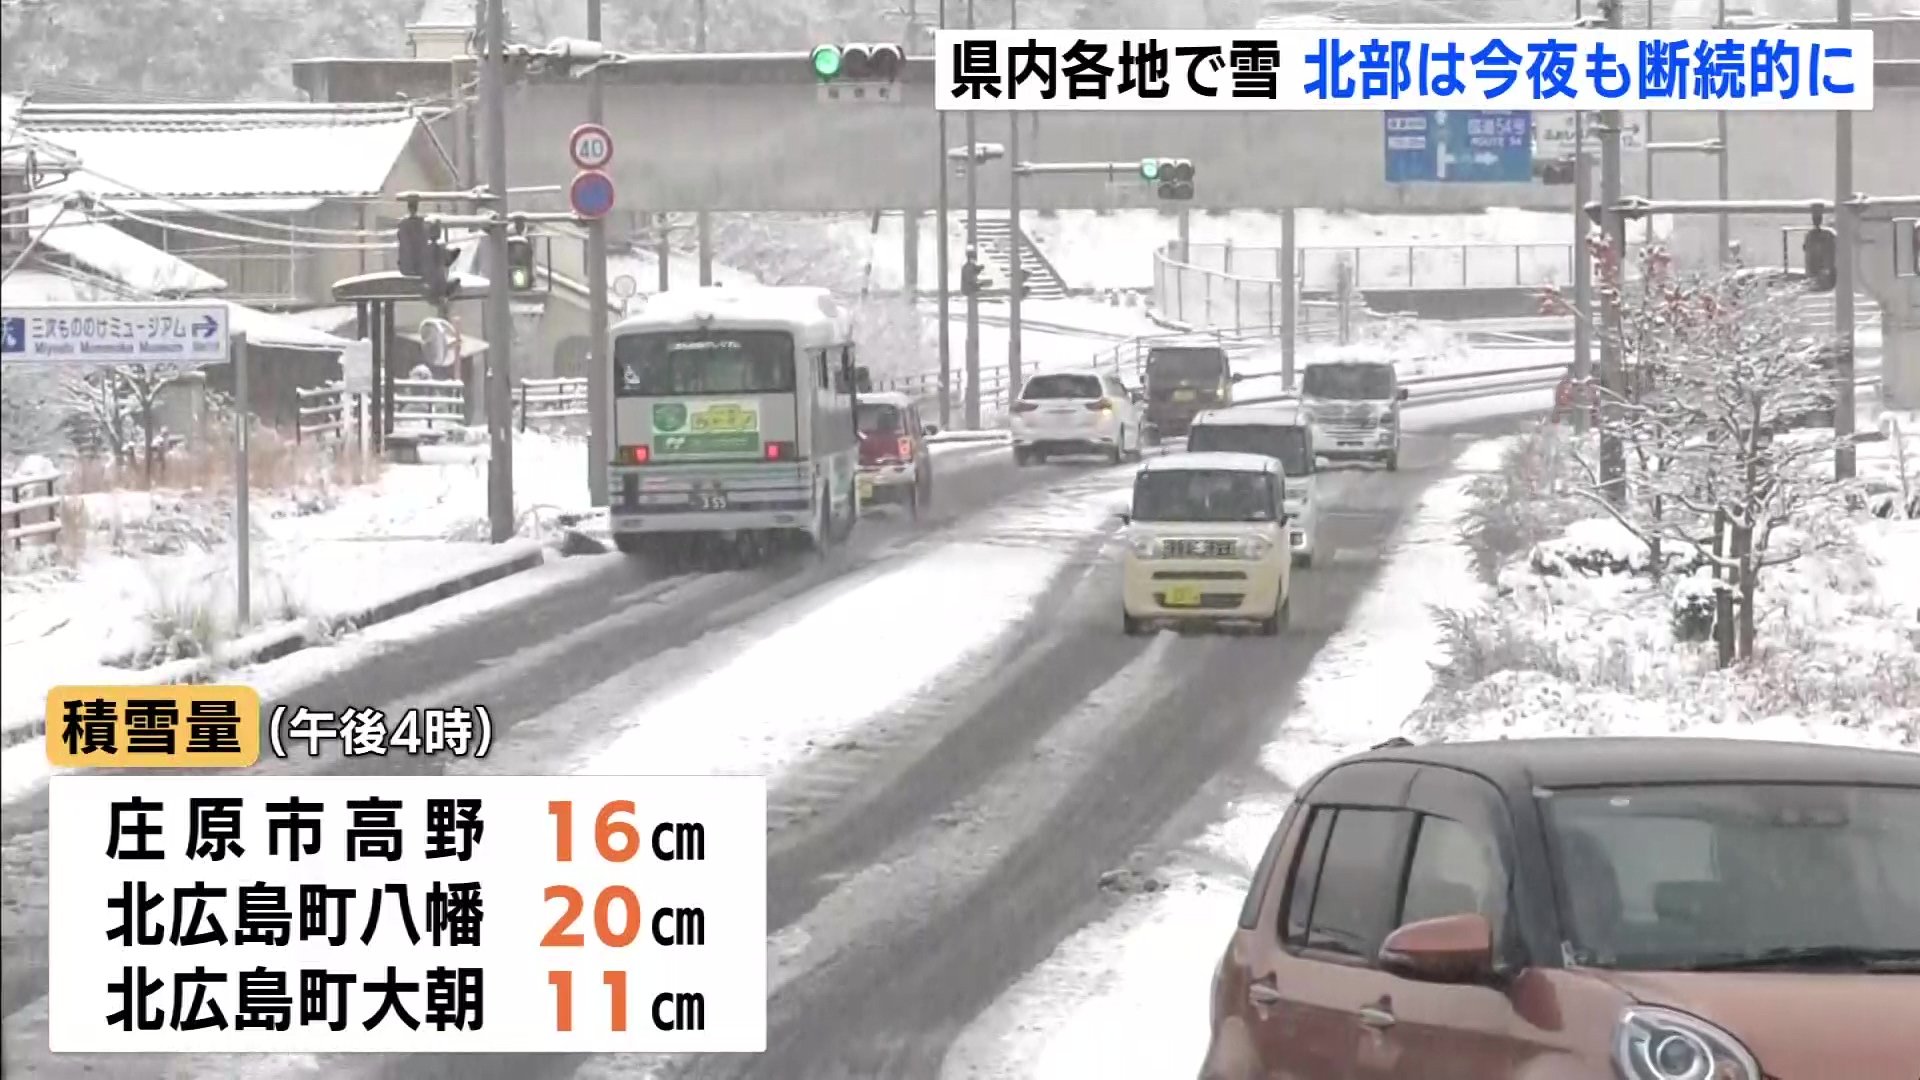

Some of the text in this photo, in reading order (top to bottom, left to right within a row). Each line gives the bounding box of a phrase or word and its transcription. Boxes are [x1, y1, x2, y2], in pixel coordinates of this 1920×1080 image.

[579, 138, 605, 159] 40
[31, 316, 187, 338] 三次もののけミュージアム
